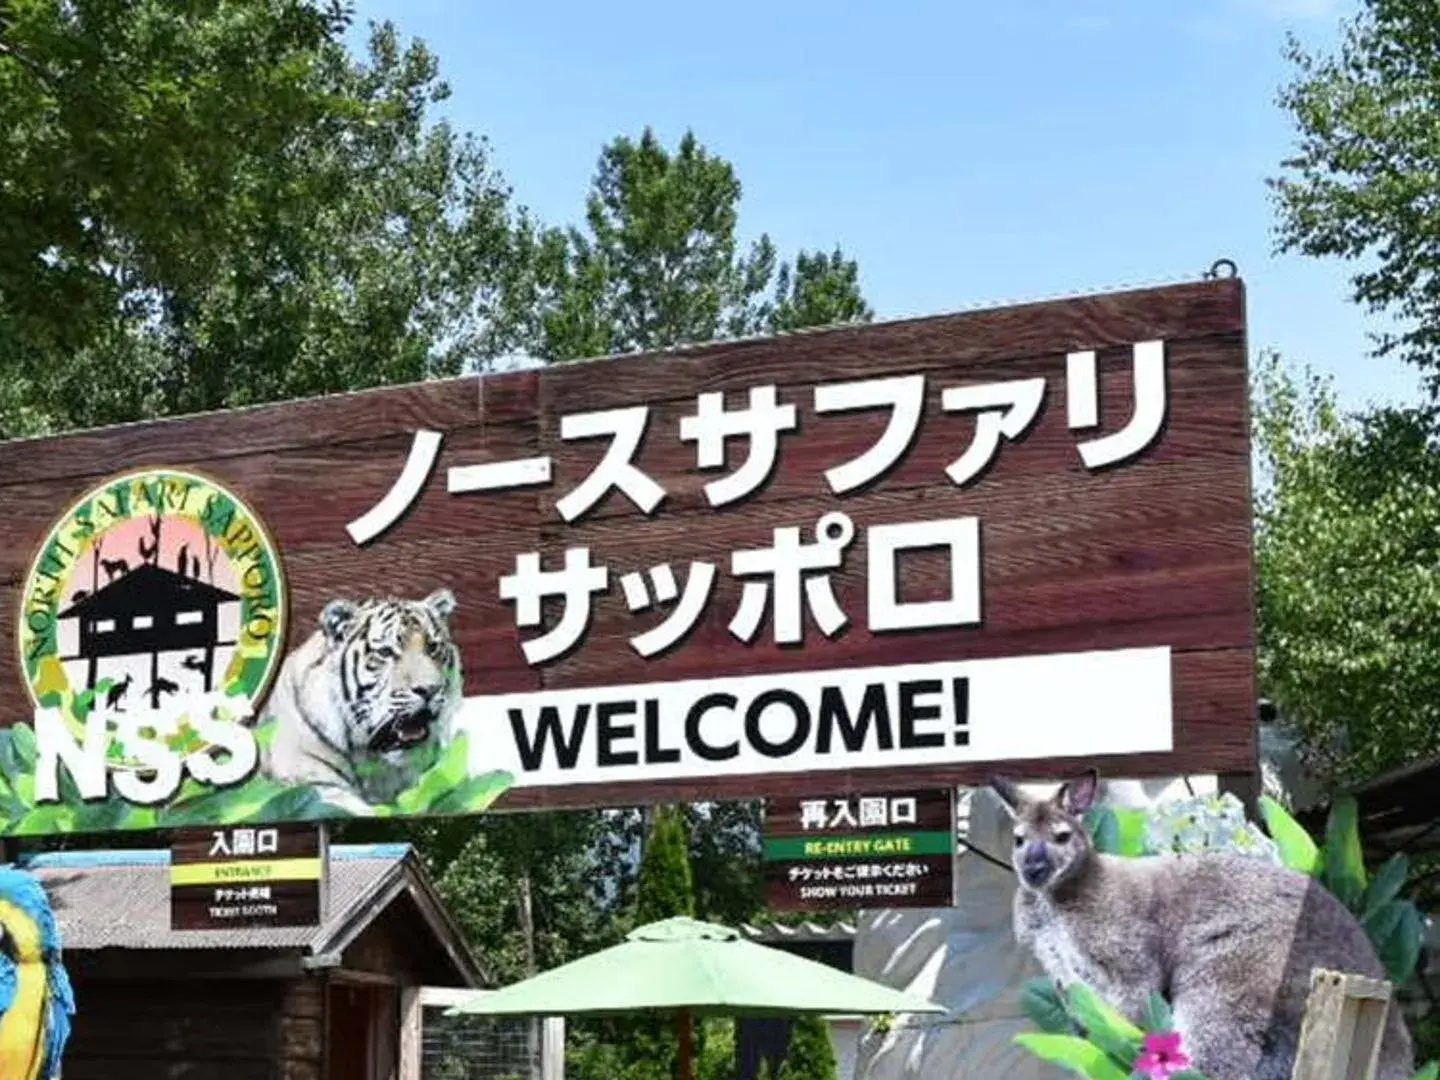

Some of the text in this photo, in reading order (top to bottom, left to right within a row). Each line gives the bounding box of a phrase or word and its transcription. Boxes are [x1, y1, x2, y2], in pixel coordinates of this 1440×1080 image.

[344, 340, 1166, 546] ノースサファリ
[200, 492, 274, 641] SAPPORO
[498, 512, 981, 664] サッポロ
[33, 694, 260, 805] NSS
[507, 676, 971, 771] WELCOME!
[209, 828, 278, 857] 入園口
[799, 796, 917, 830] 再入園口
[803, 837, 911, 855] RE-ENTRY GATE
[800, 885, 837, 899] SHOW
[840, 884, 873, 898] YOUR
